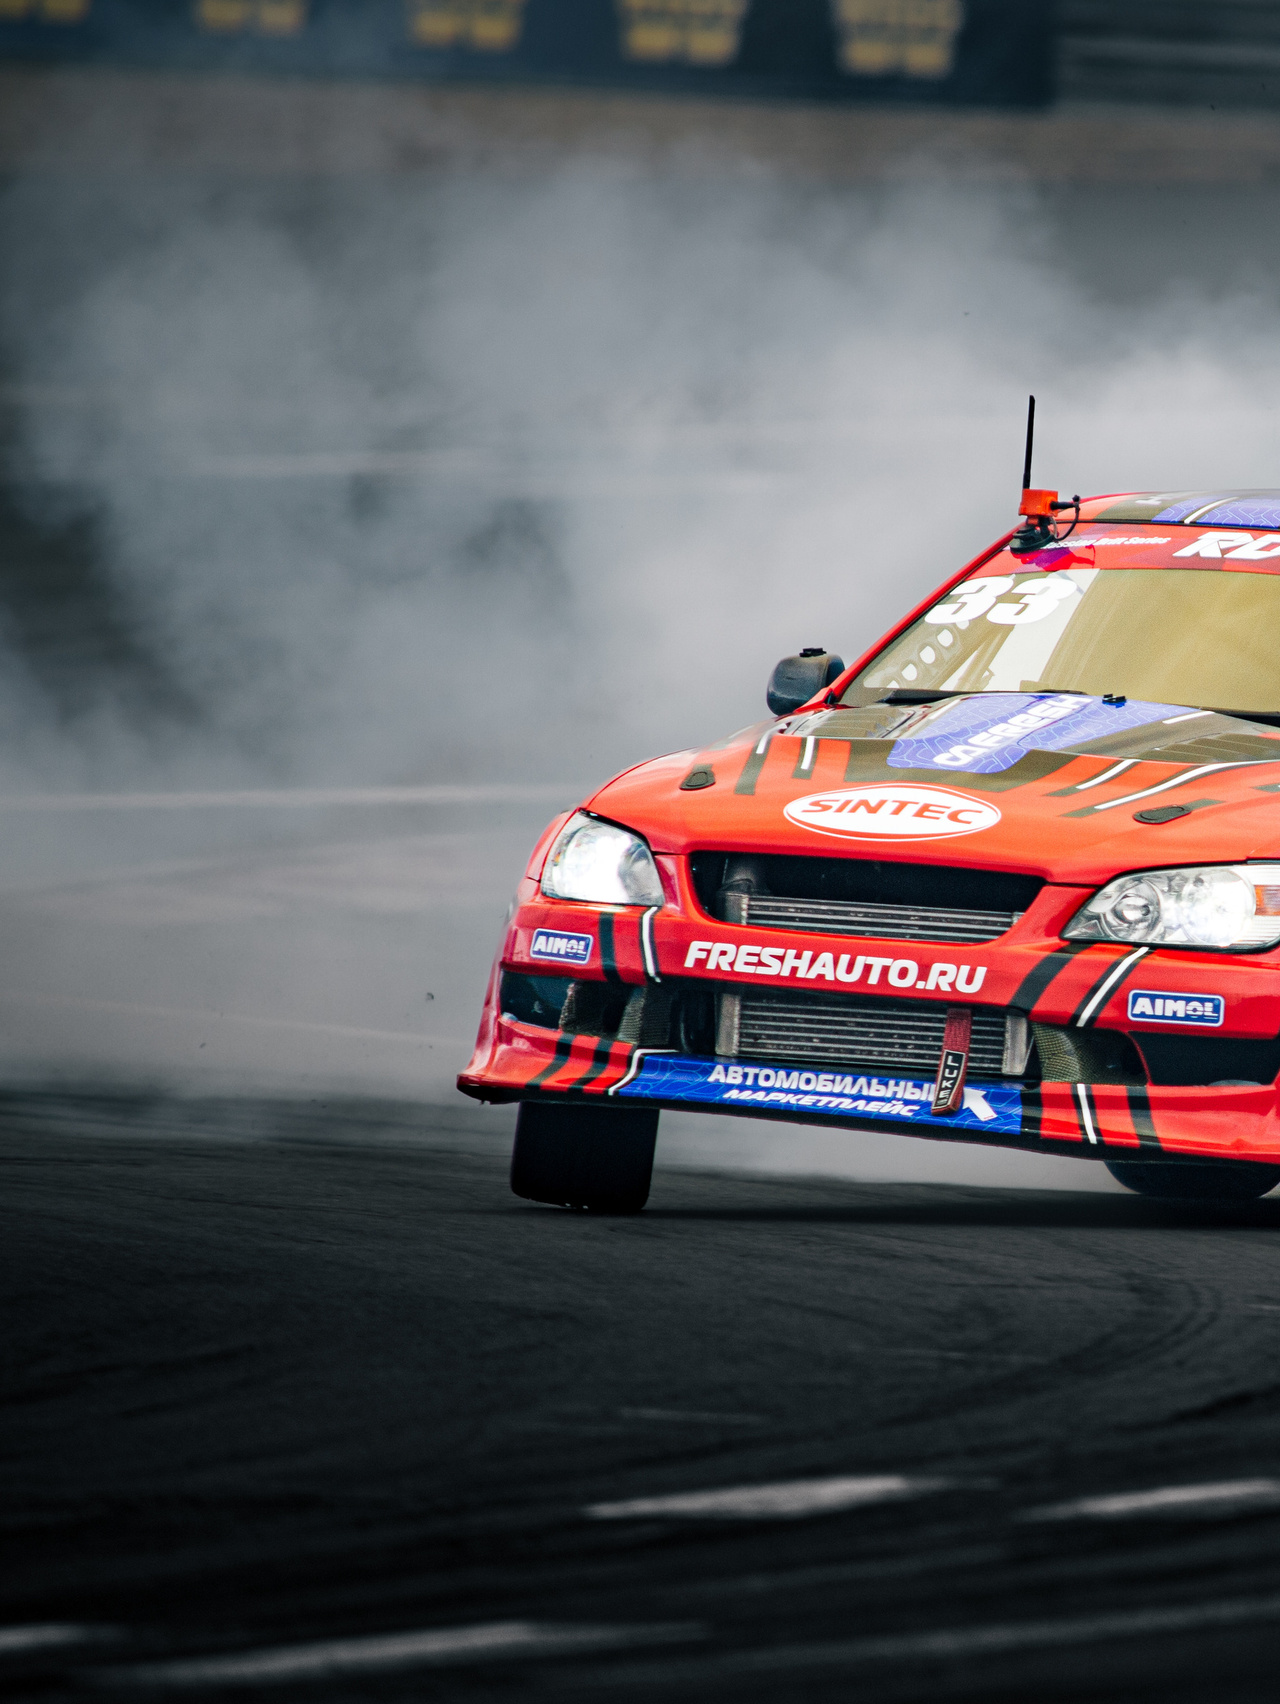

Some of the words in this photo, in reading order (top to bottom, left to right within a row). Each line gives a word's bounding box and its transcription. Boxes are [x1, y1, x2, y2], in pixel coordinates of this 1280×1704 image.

[1124, 536, 1172, 545] Series
[924, 576, 1077, 625] 33
[801, 799, 983, 824] SINTEC
[533, 935, 587, 957] AIMOL
[684, 940, 987, 994] FRESHAUTO.RU
[1132, 997, 1218, 1020] AIMOL
[723, 1089, 920, 1117] МАРКЕТПЛЕЙС
